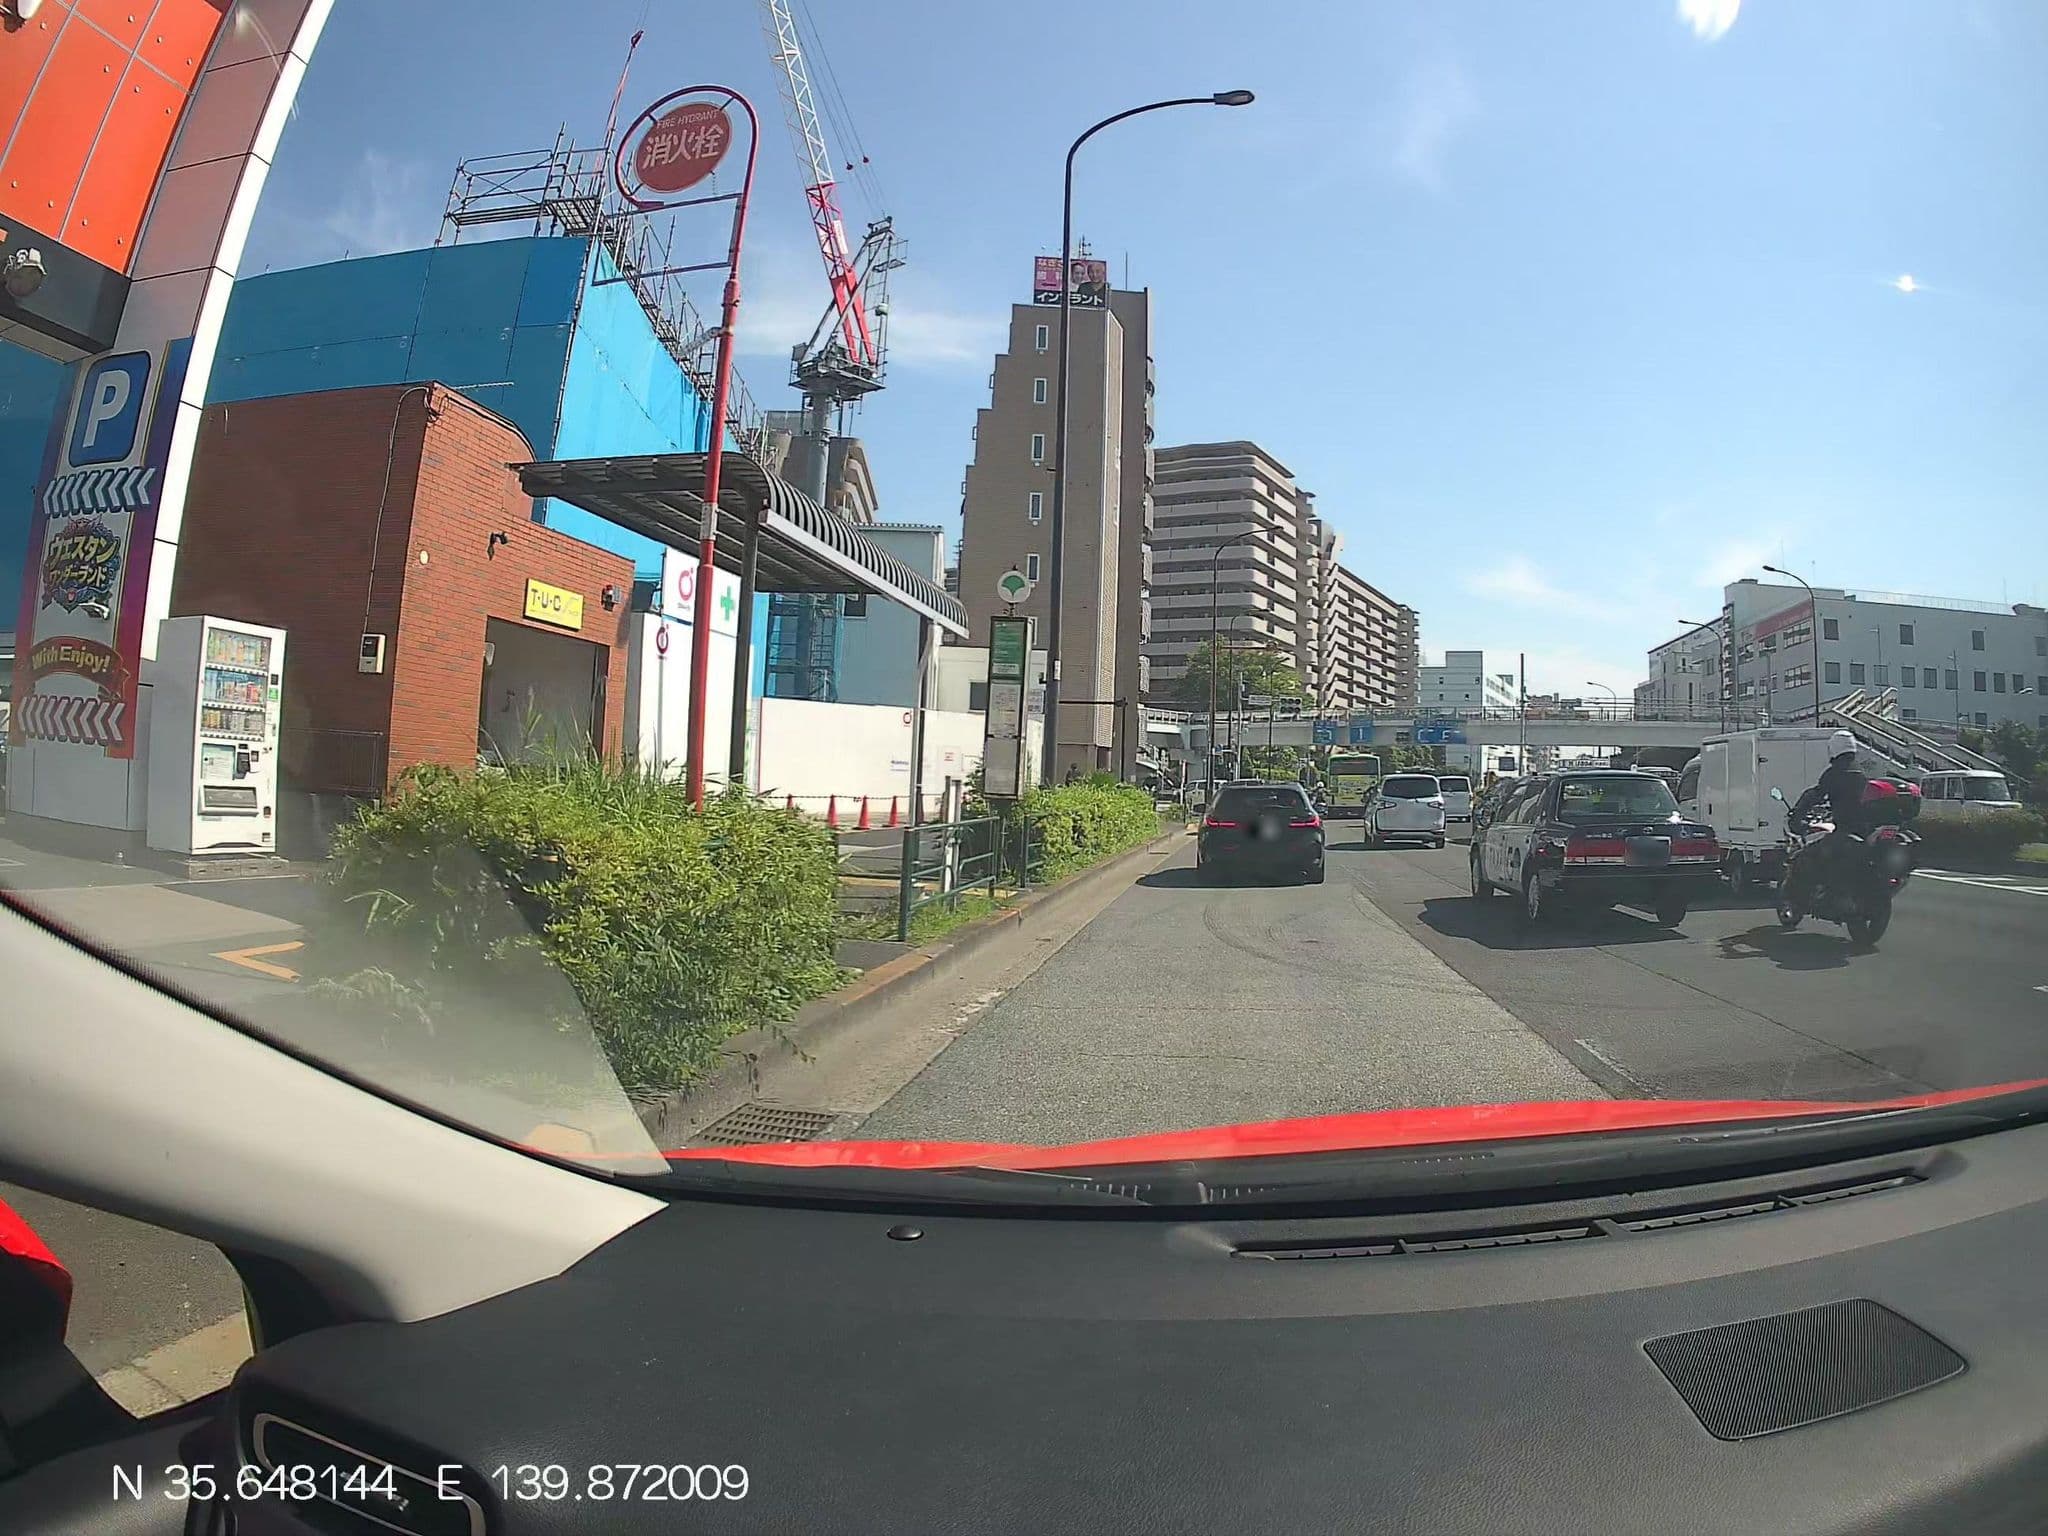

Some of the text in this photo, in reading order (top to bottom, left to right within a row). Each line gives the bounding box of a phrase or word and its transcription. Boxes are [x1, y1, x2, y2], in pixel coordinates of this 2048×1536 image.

[657, 110, 718, 128] FIRE HYDRANT
[642, 124, 724, 169] 消火栓
[1037, 292, 1103, 306] インラント
[82, 369, 130, 448] P
[49, 535, 117, 568] ウエスタン
[32, 646, 111, 674] With Enjoy!
